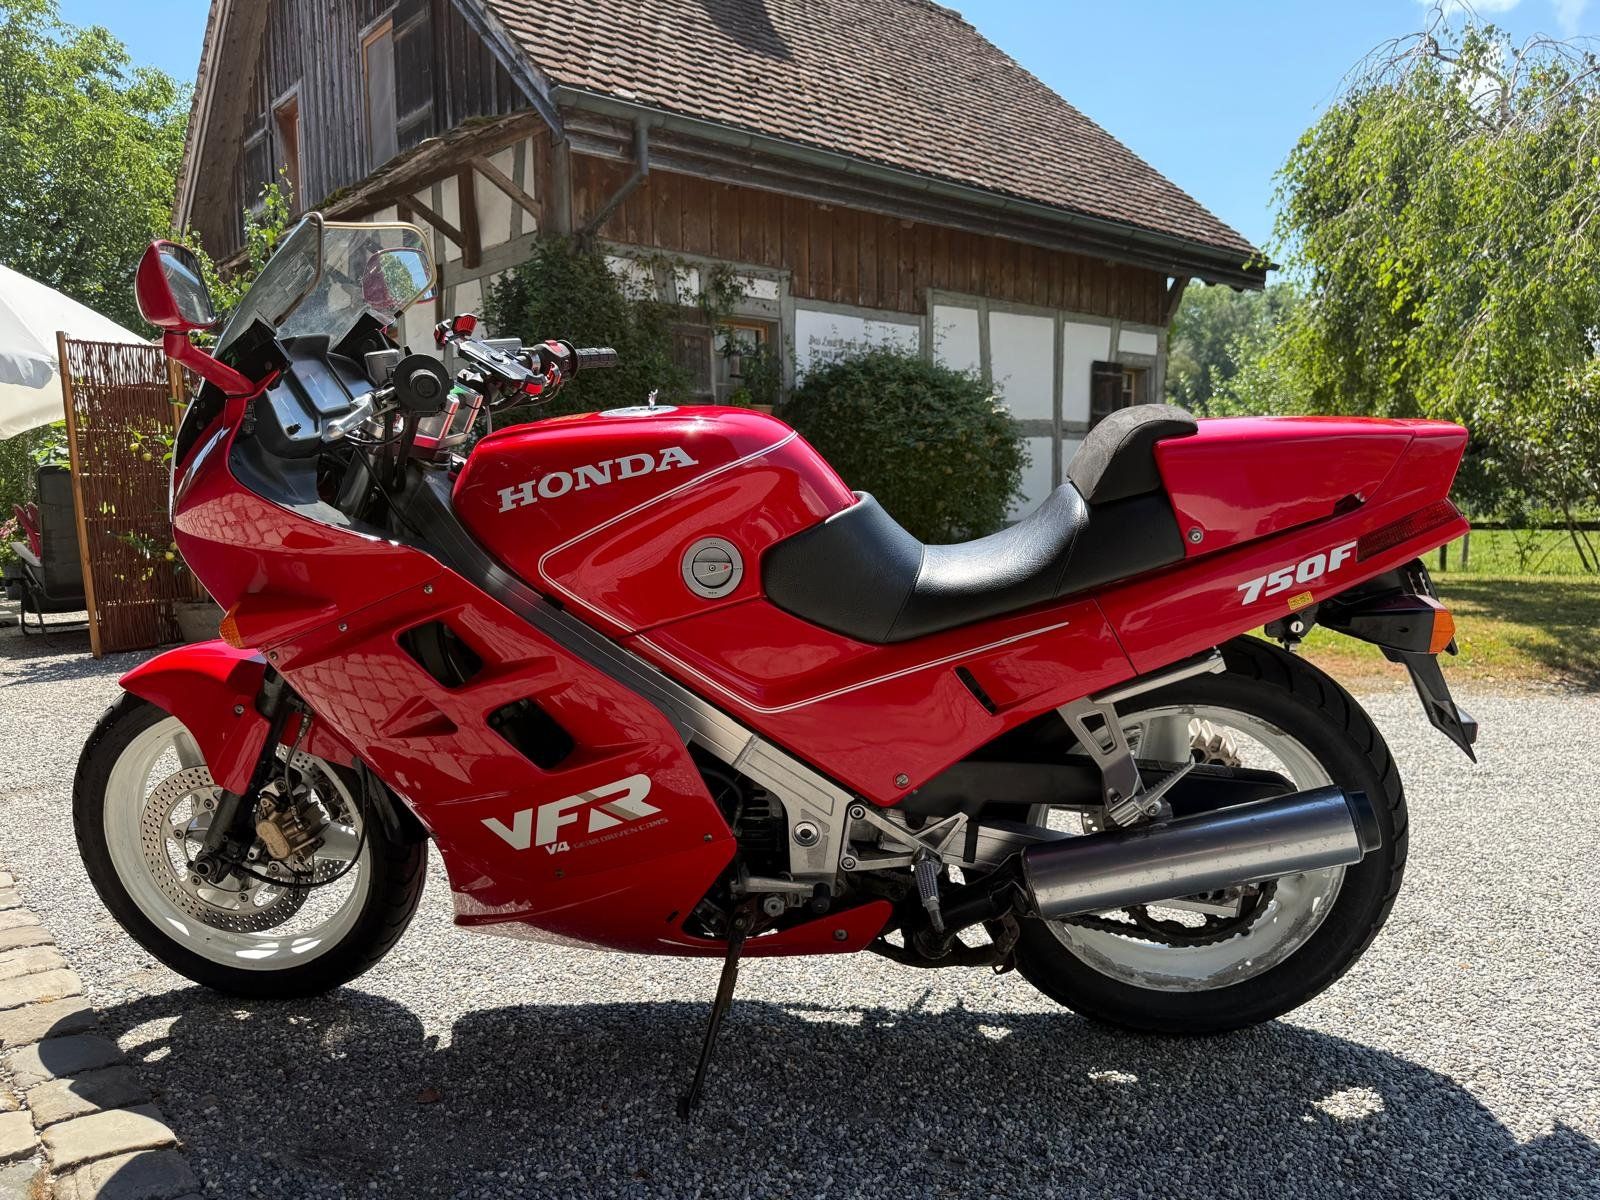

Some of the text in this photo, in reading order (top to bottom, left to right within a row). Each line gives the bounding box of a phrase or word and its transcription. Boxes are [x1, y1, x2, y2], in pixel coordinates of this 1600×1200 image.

[497, 446, 699, 513] HONDA
[1237, 540, 1357, 606] 750F
[480, 773, 662, 850] VFR
[545, 841, 570, 855] V4
[599, 827, 638, 843] DRIVEN
[638, 817, 669, 832] CAMS
